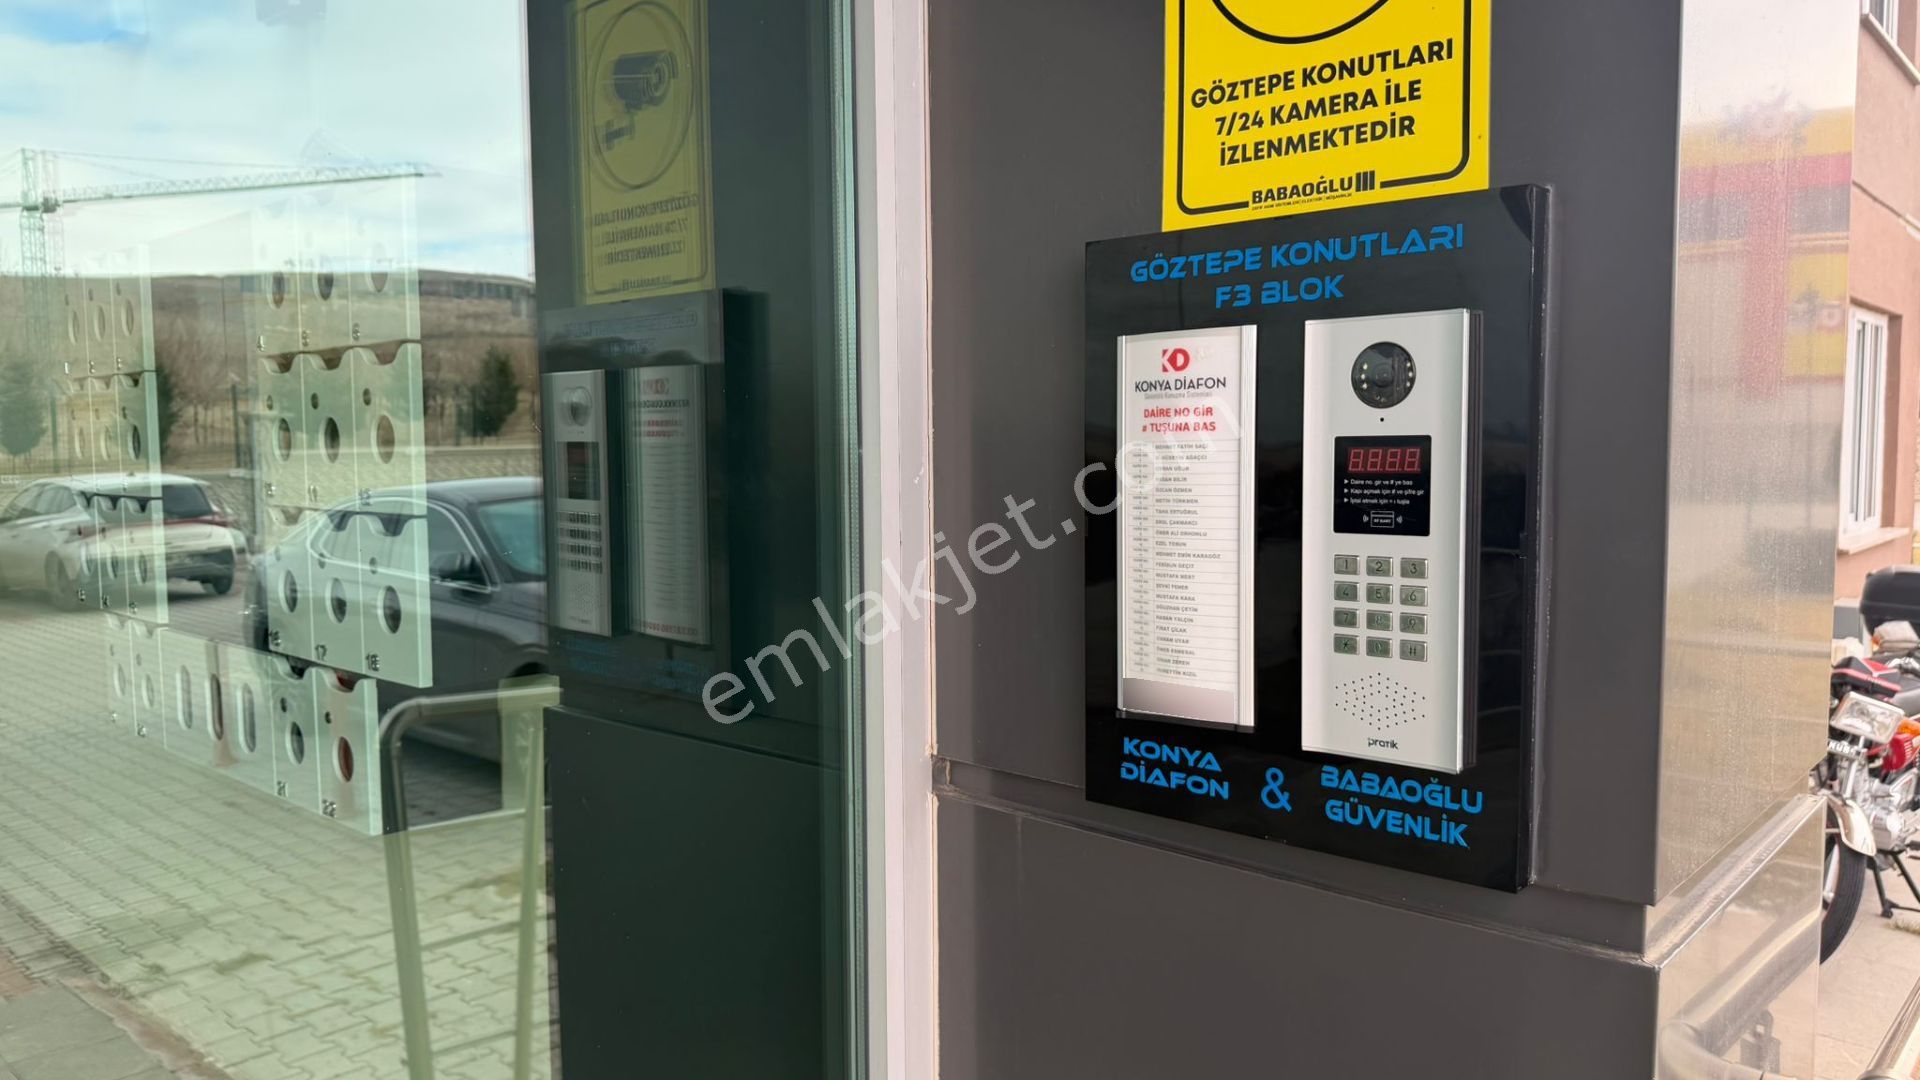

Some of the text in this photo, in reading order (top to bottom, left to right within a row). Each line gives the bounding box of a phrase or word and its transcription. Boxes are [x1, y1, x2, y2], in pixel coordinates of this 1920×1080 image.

[1191, 38, 1454, 108] GÖZTEPE KONUTLARI
[1215, 78, 1422, 136] 7/24 KAMERA İLE
[1219, 111, 1415, 166] İZLENMEKTEDİR
[1252, 175, 1353, 204] BABAOĞLU
[1130, 223, 1464, 283] GÖZTEPE KONUTLARI
[1215, 274, 1345, 309] F3 BLOK
[1134, 375, 1227, 393] KONYA DİAFON
[1143, 406, 1213, 419] DAİRE NO GİR
[1150, 422, 1190, 435] TUŞUNA
[1193, 421, 1216, 432] BAS
[1344, 559, 1349, 570] 1
[1375, 561, 1383, 572] 2
[1410, 562, 1418, 574] 3
[1342, 586, 1349, 597] 4
[1375, 588, 1382, 599] 5
[1409, 590, 1417, 602] 6
[1343, 613, 1349, 623] 7
[1409, 618, 1416, 629] 9
[1367, 737, 1399, 749] pratik
[1123, 736, 1222, 772] KONYA
[1120, 760, 1229, 800] DİAFON
[1320, 764, 1484, 814] BABAOĞLU
[1260, 767, 1292, 812] &
[1325, 796, 1470, 849] GÜVENLİK
